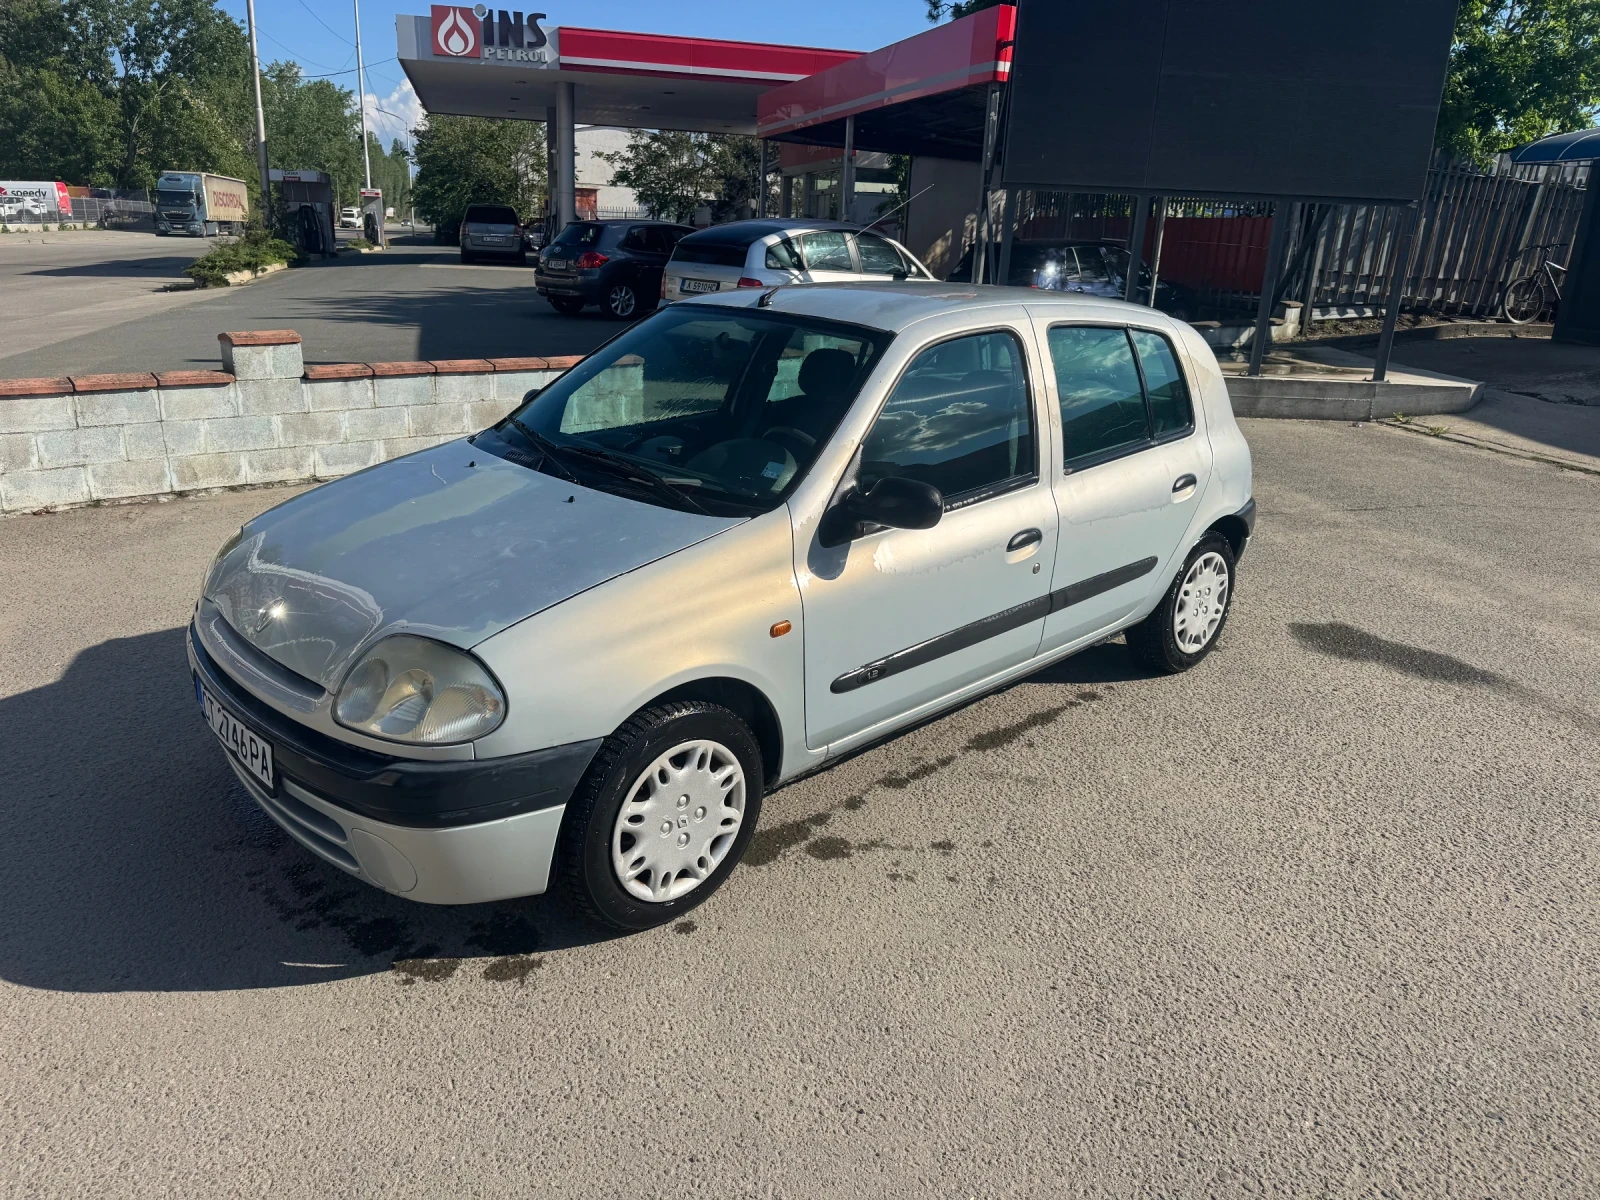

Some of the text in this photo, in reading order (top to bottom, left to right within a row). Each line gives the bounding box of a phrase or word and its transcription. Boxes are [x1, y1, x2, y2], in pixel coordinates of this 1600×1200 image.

[483, 9, 548, 48] INS
[484, 46, 548, 63] PETROL
[11, 188, 47, 199] speedy
[213, 190, 241, 209] DISCORDIA
